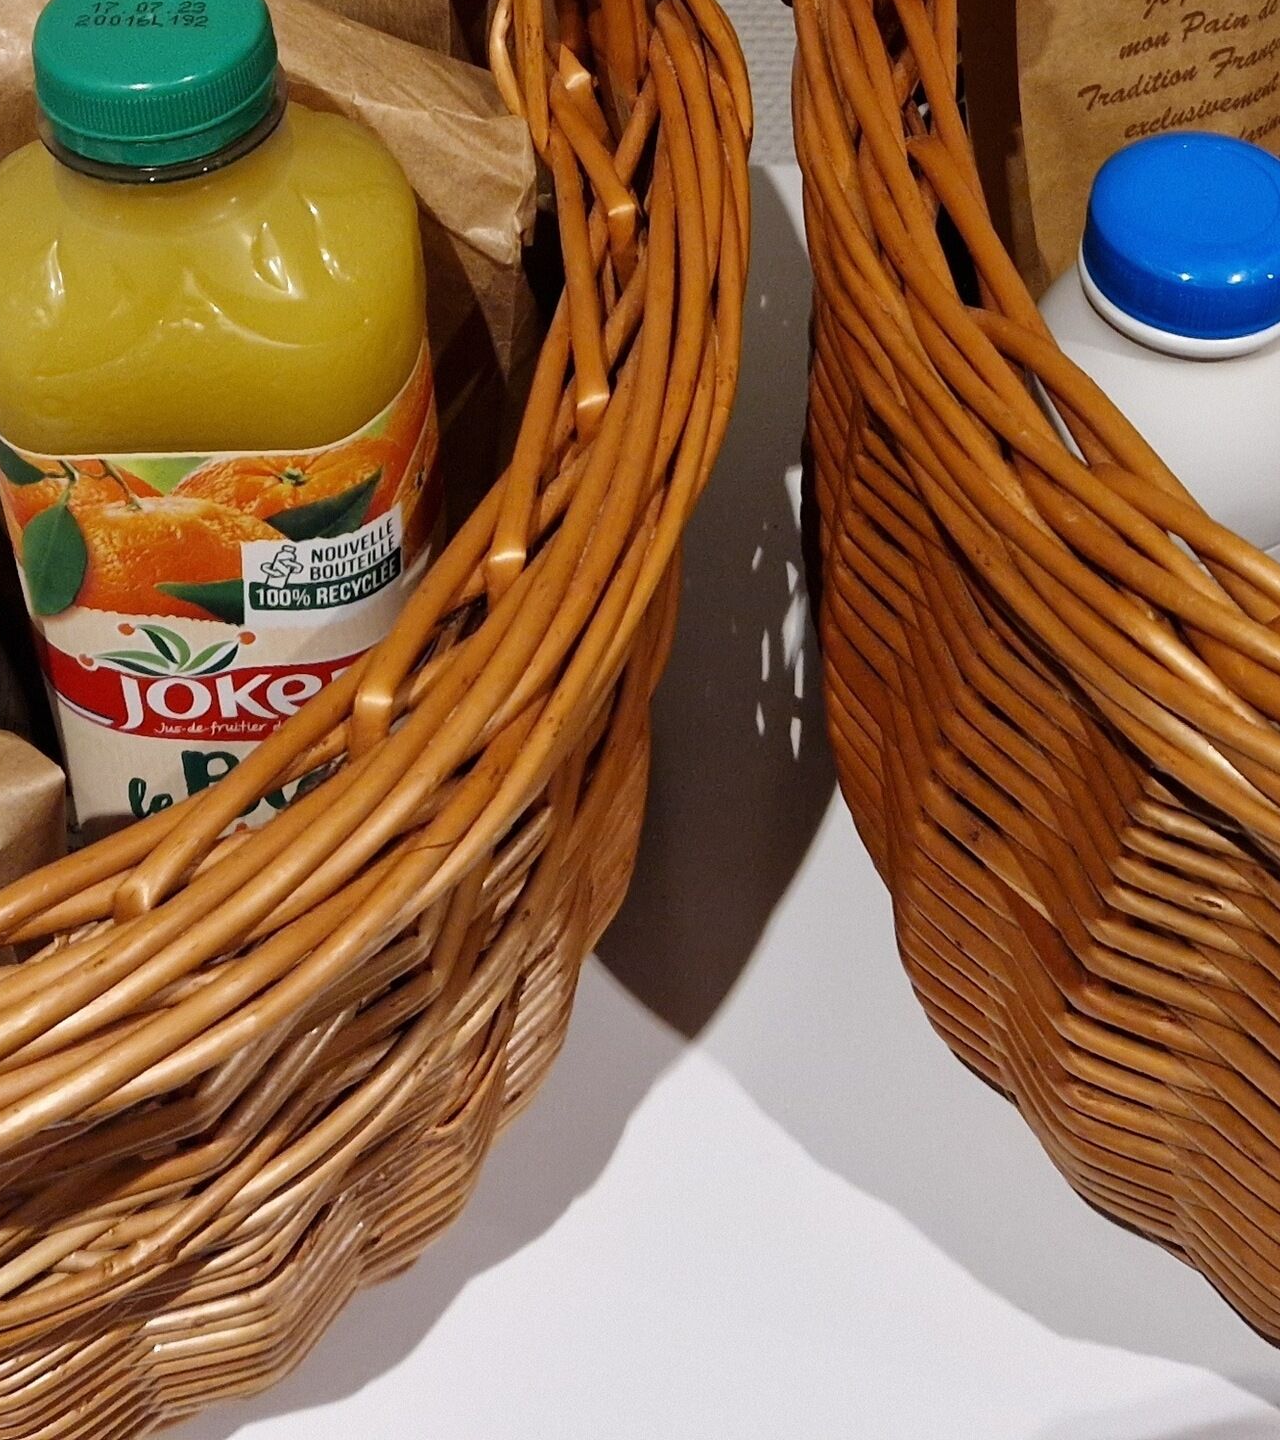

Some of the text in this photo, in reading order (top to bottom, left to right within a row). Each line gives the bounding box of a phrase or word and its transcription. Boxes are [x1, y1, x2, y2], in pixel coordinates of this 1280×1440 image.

[1118, 31, 1170, 60] mon
[1180, 10, 1250, 43] Pain
[1077, 64, 1198, 111] Tradition
[1124, 71, 1280, 139] exclusivement
[309, 534, 396, 581] BOUTEILLE
[311, 517, 394, 564] NOUVELLE
[255, 556, 397, 607] 100% RECYCLÉE
